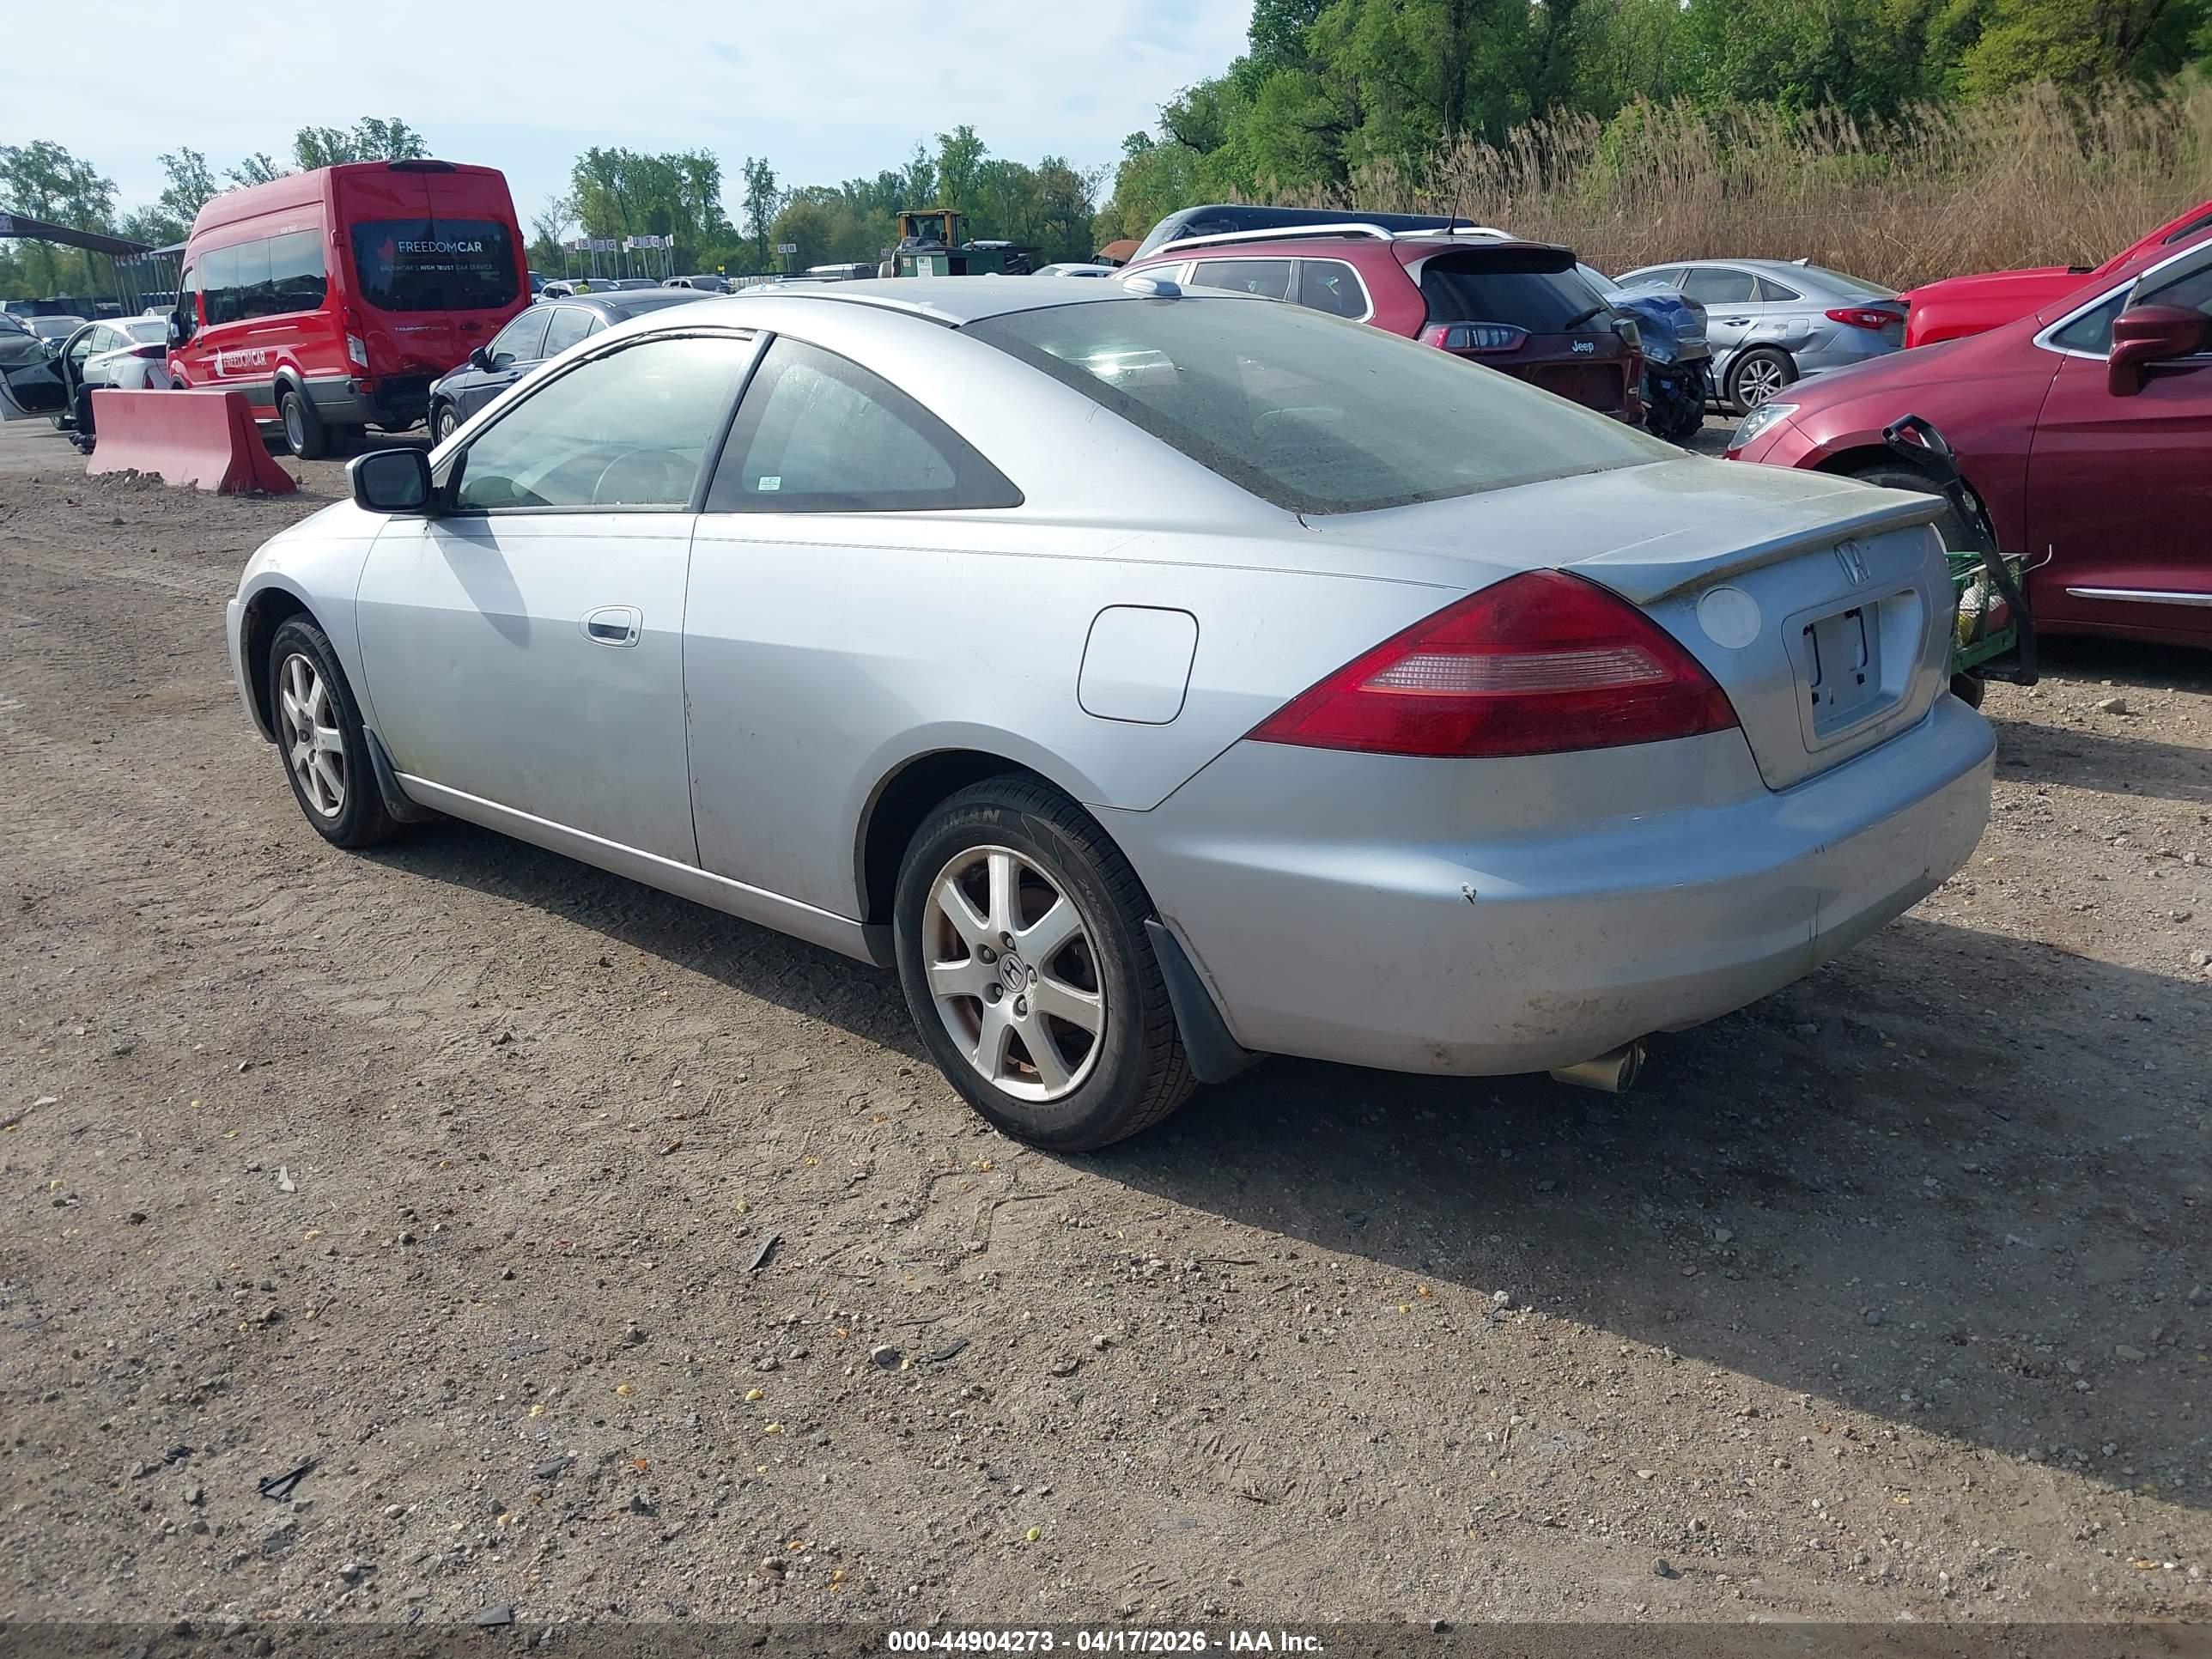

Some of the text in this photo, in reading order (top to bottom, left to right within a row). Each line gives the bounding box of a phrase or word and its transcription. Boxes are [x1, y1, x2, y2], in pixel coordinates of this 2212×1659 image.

[398, 241, 483, 252] FREEDOMCAR
[1571, 340, 1594, 354] Jeep
[223, 350, 267, 368] FREEDOMCAR
